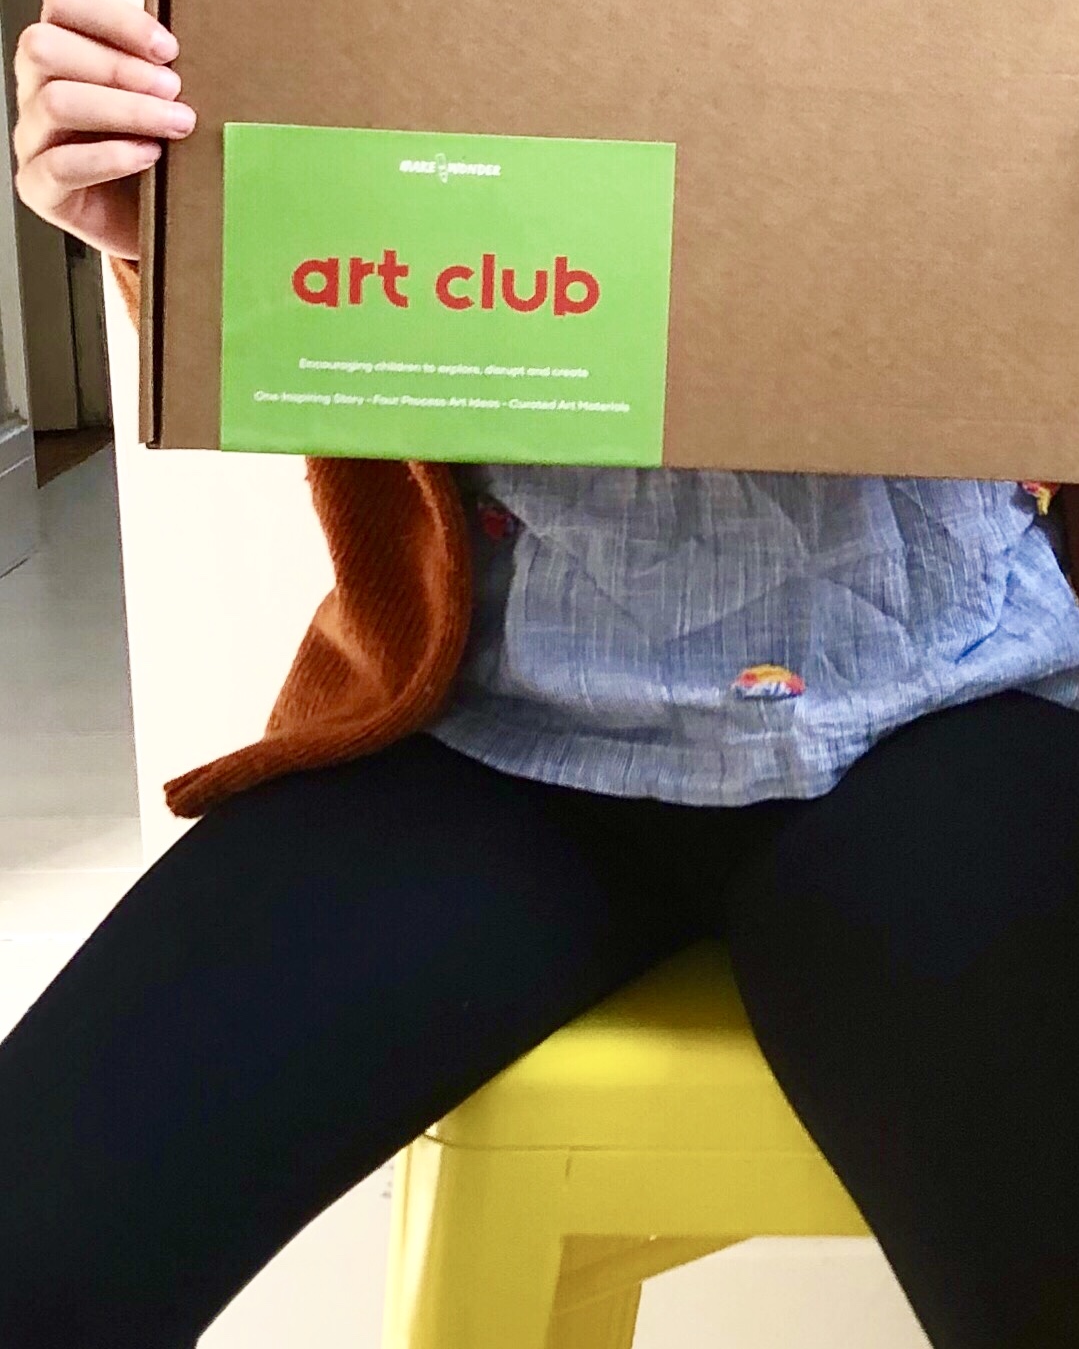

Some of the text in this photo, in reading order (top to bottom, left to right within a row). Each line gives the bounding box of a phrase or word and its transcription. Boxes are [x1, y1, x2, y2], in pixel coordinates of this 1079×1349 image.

[291, 249, 601, 317] art club
[298, 357, 373, 373] Encouraging
[374, 361, 421, 372] children
[422, 363, 436, 373] to
[484, 365, 525, 377] disrupt
[526, 366, 551, 377] and
[551, 367, 590, 378] create
[253, 390, 279, 401] One
[281, 391, 331, 405] Inspiring
[333, 392, 364, 405] Story
[373, 393, 399, 405] Four
[449, 397, 467, 407] Art
[557, 399, 576, 410] Art
[577, 400, 630, 412] Materials
